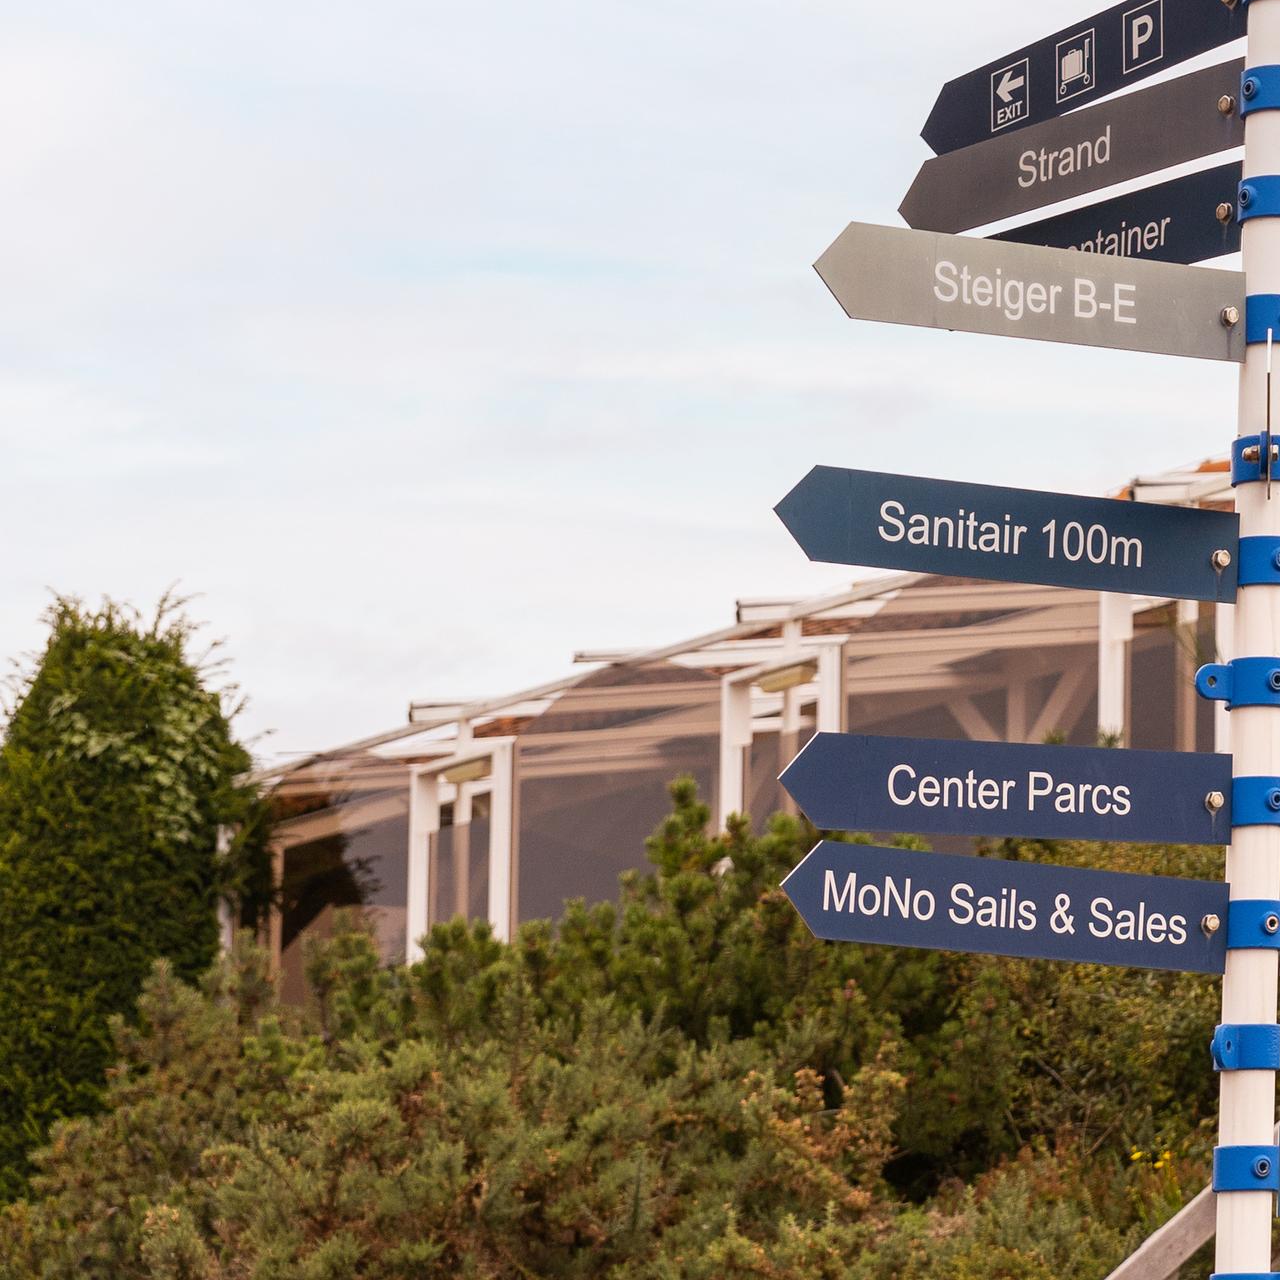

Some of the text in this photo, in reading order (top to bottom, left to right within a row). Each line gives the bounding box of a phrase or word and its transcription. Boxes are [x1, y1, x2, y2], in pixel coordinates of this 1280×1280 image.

[1132, 14, 1154, 60] P
[996, 100, 1023, 125] EXIT
[1017, 124, 1111, 188] Strand
[933, 260, 1137, 324] Steiger B-E
[877, 500, 1143, 568] Sanitair 100m
[887, 763, 1132, 817] Center Parcs
[822, 869, 1188, 946] MoNo Sails & Sales
